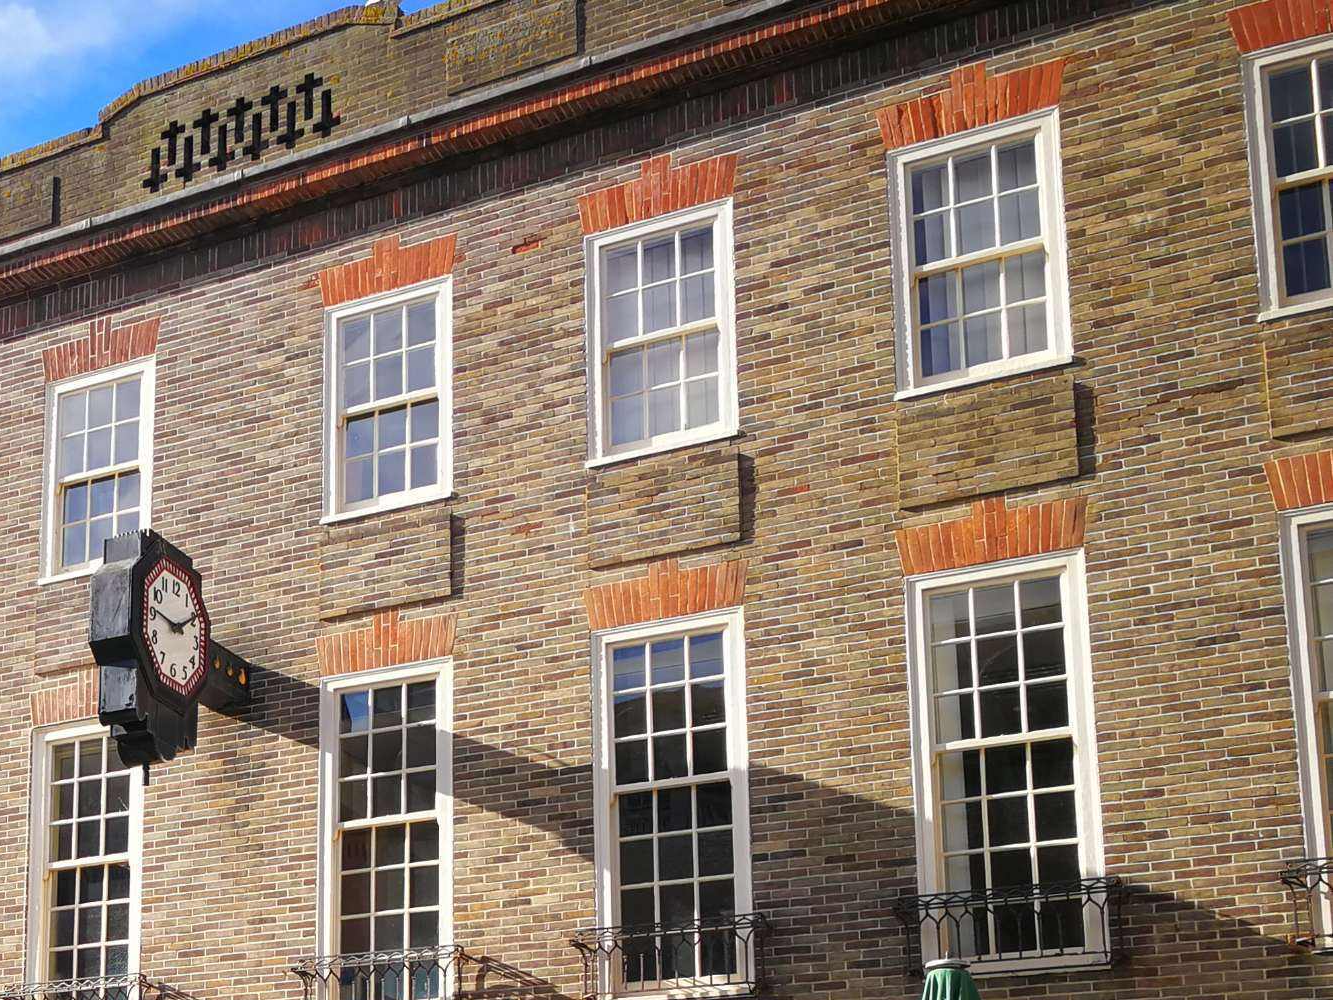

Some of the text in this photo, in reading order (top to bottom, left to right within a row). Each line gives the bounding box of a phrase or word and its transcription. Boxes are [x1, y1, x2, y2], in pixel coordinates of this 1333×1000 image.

[161, 576, 168, 593] 11
[172, 579, 181, 597] 12
[153, 586, 163, 604] 10
[149, 606, 157, 620] 9
[151, 629, 158, 645] 8
[192, 635, 199, 651] 3
[159, 650, 166, 664] 7
[189, 655, 196, 669] 4
[169, 663, 177, 678] 6
[181, 665, 188, 680] 5
